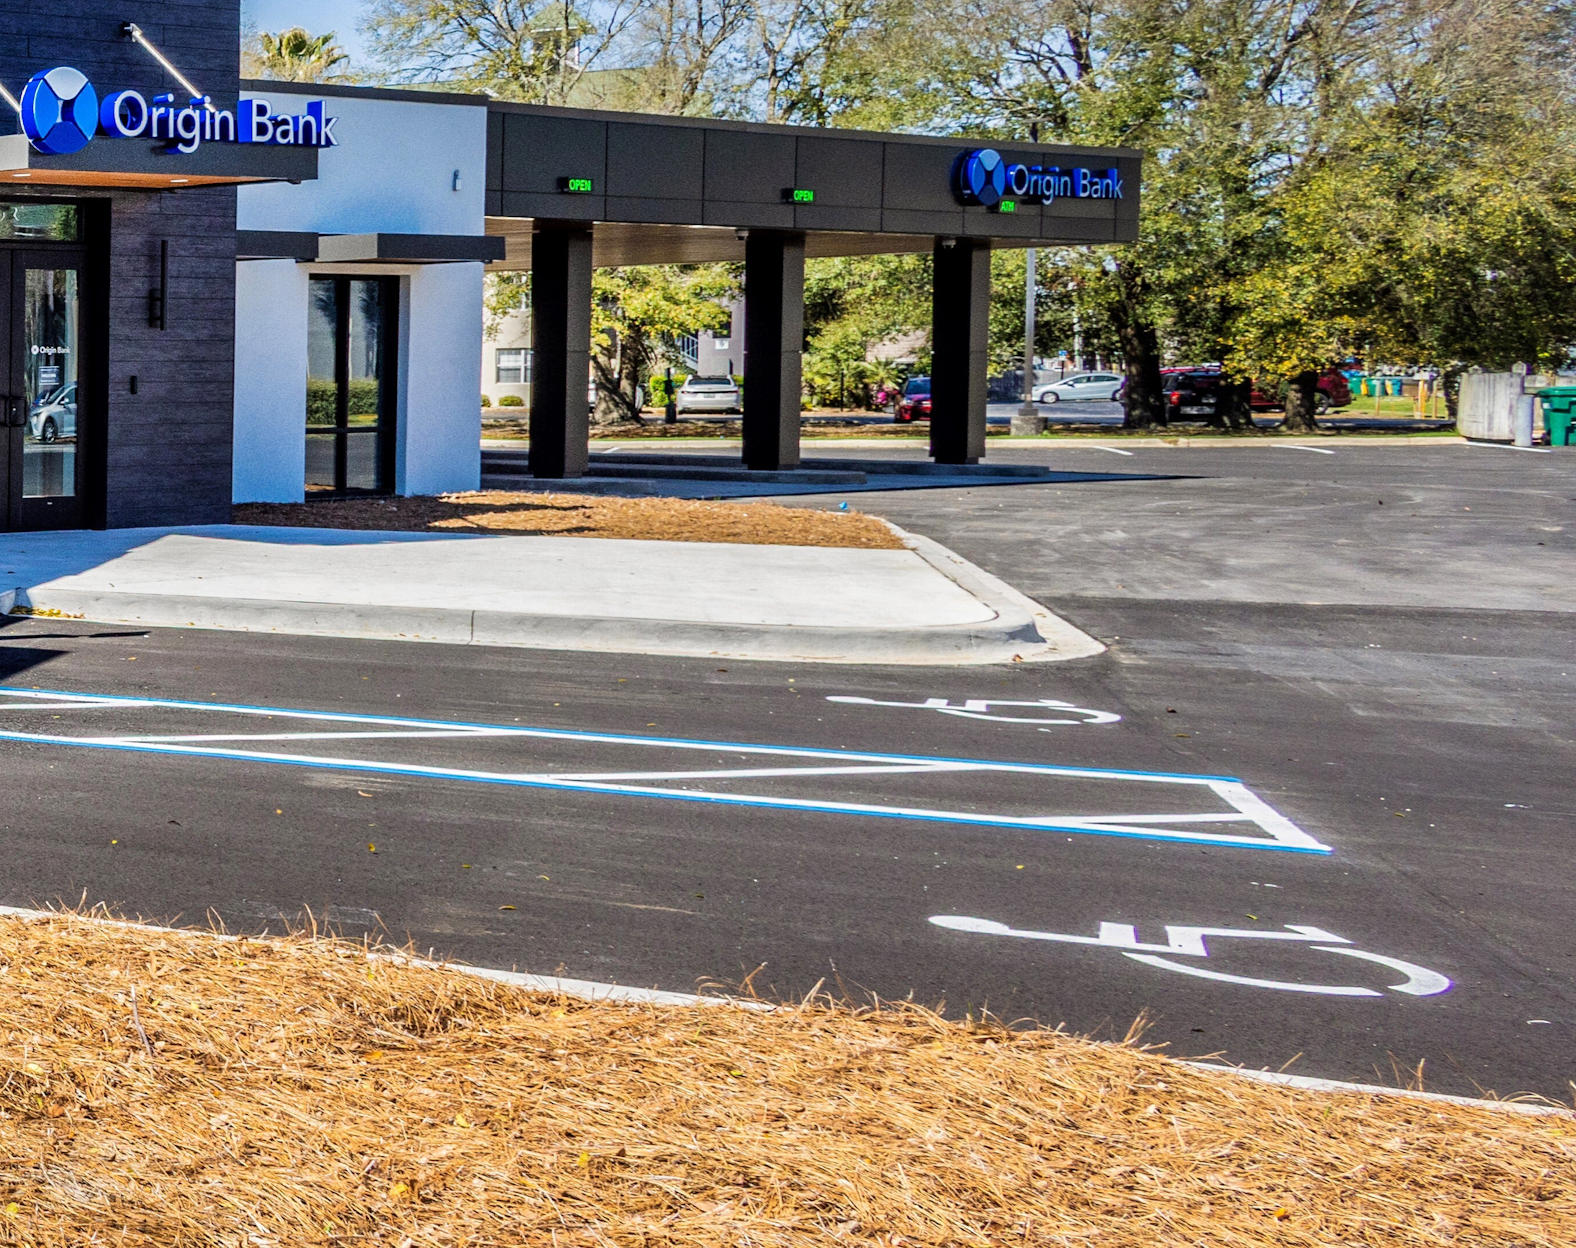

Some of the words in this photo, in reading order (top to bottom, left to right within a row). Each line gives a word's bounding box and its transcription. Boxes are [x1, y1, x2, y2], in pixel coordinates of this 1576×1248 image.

[112, 90, 235, 153] Origin
[250, 98, 338, 147] Bank
[568, 178, 592, 192] OPEN
[1012, 164, 1072, 205] Origin
[1079, 168, 1123, 199] Bank
[793, 189, 814, 202] OPEN
[1000, 200, 1015, 212] ATM
[39, 345, 56, 355] Origin
